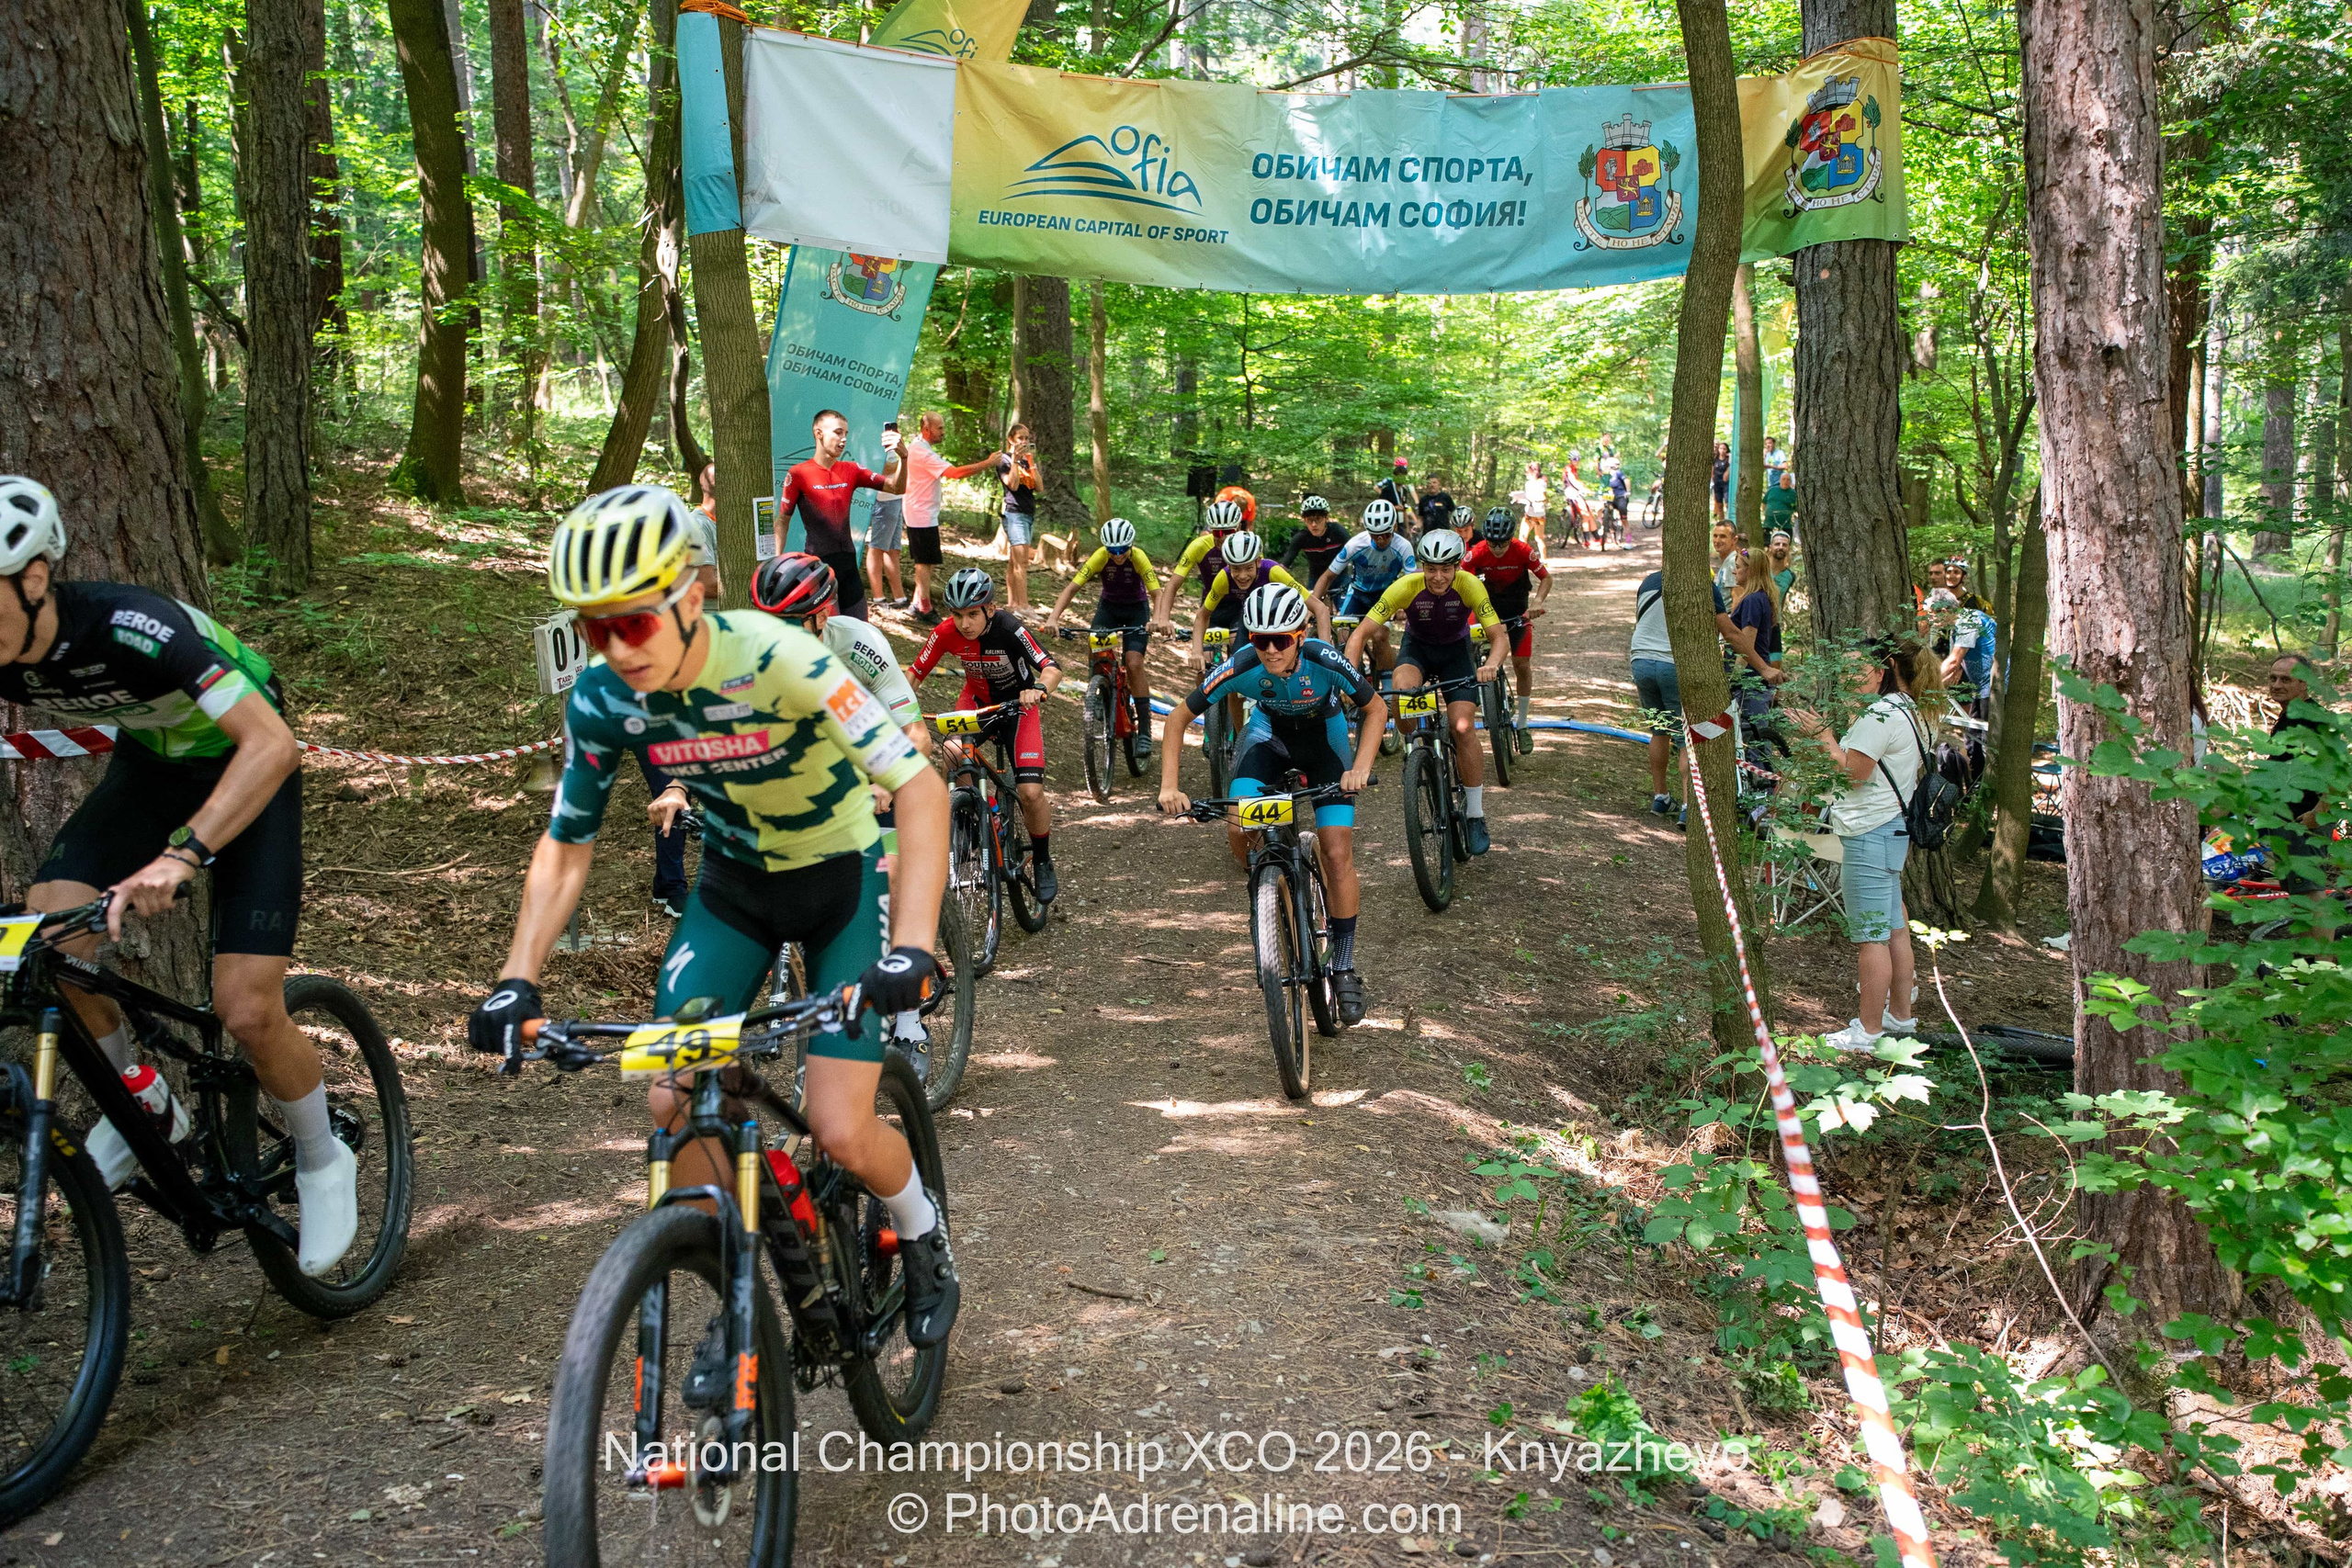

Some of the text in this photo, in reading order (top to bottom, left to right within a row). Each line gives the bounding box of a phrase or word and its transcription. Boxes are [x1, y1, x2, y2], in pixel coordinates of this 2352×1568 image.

[1251, 152, 1533, 186] ОБИЧАМ СПОРТА,
[978, 209, 1229, 244] EUROPEAN CAPITAL OF SPORT
[1250, 197, 1527, 230] ОБИЧАМ СОФИЯ!
[1577, 206, 1603, 246] РАСТЕ
[1611, 239, 1628, 247] НО
[1632, 238, 1650, 247] НЕ
[783, 359, 898, 401] ОБИЧАМ СОФИЯ!
[786, 343, 903, 389] ОБИЧАМ СПОРТА,
[109, 609, 175, 644] BEROE
[116, 627, 155, 655] ROAD
[1205, 631, 1223, 643] 39
[853, 640, 889, 672] BEROE
[1018, 633, 1038, 660] SOUDAL
[1095, 636, 1113, 648] 42
[854, 653, 876, 675] ROAD
[1203, 659, 1232, 687] DIEM
[1320, 648, 1361, 682] POMORIE
[31, 689, 140, 712] BEROE
[1407, 696, 1428, 711] 46
[945, 718, 969, 733] 51
[653, 735, 763, 763] VITOSHA
[658, 747, 789, 777] BIKE CENTER
[1250, 802, 1282, 822] 44
[648, 1029, 711, 1064] 49
